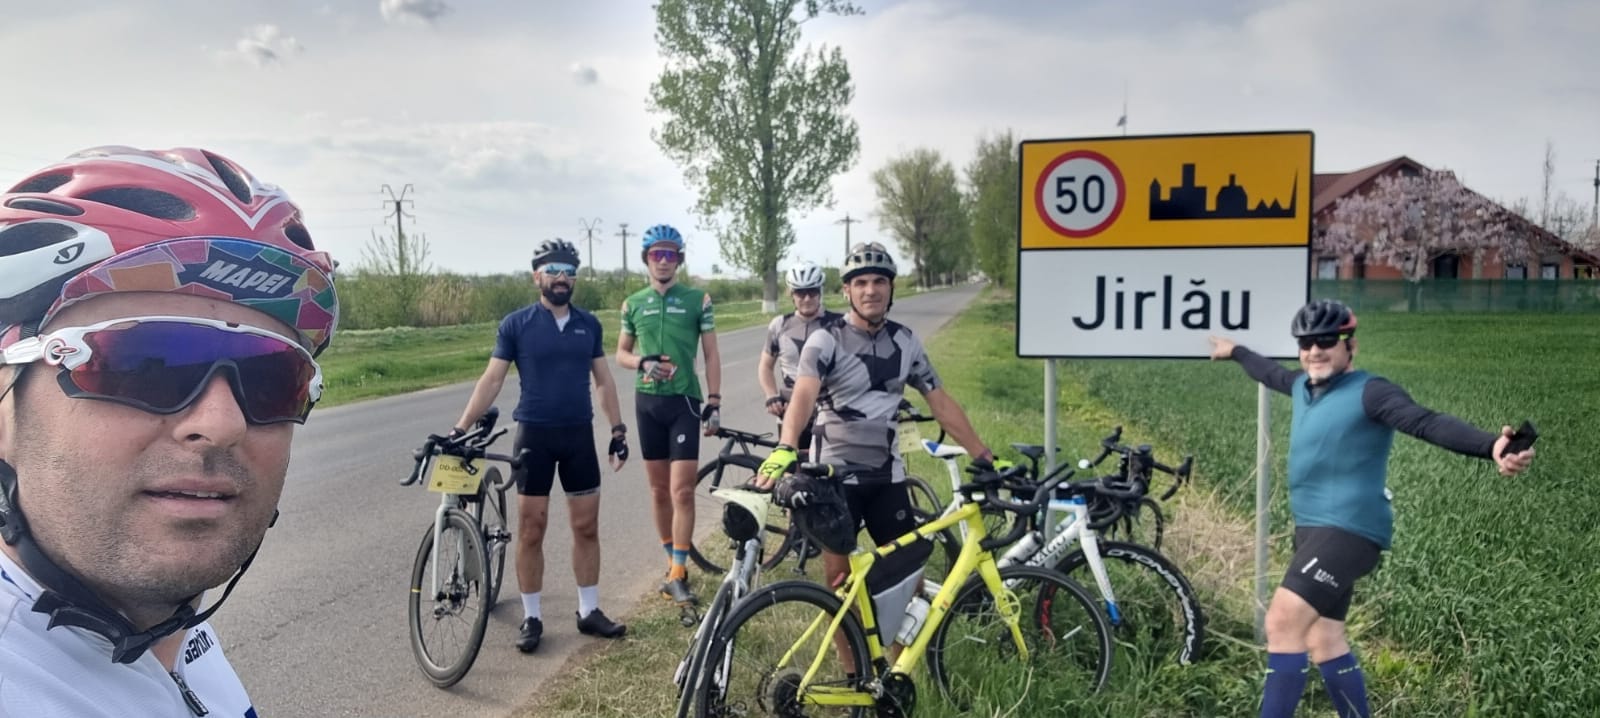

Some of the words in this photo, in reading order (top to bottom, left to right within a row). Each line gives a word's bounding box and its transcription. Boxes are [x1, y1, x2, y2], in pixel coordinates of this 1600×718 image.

[1055, 174, 1105, 214] 50
[199, 260, 292, 294] MAPEI
[1072, 275, 1251, 330] Jirlău
